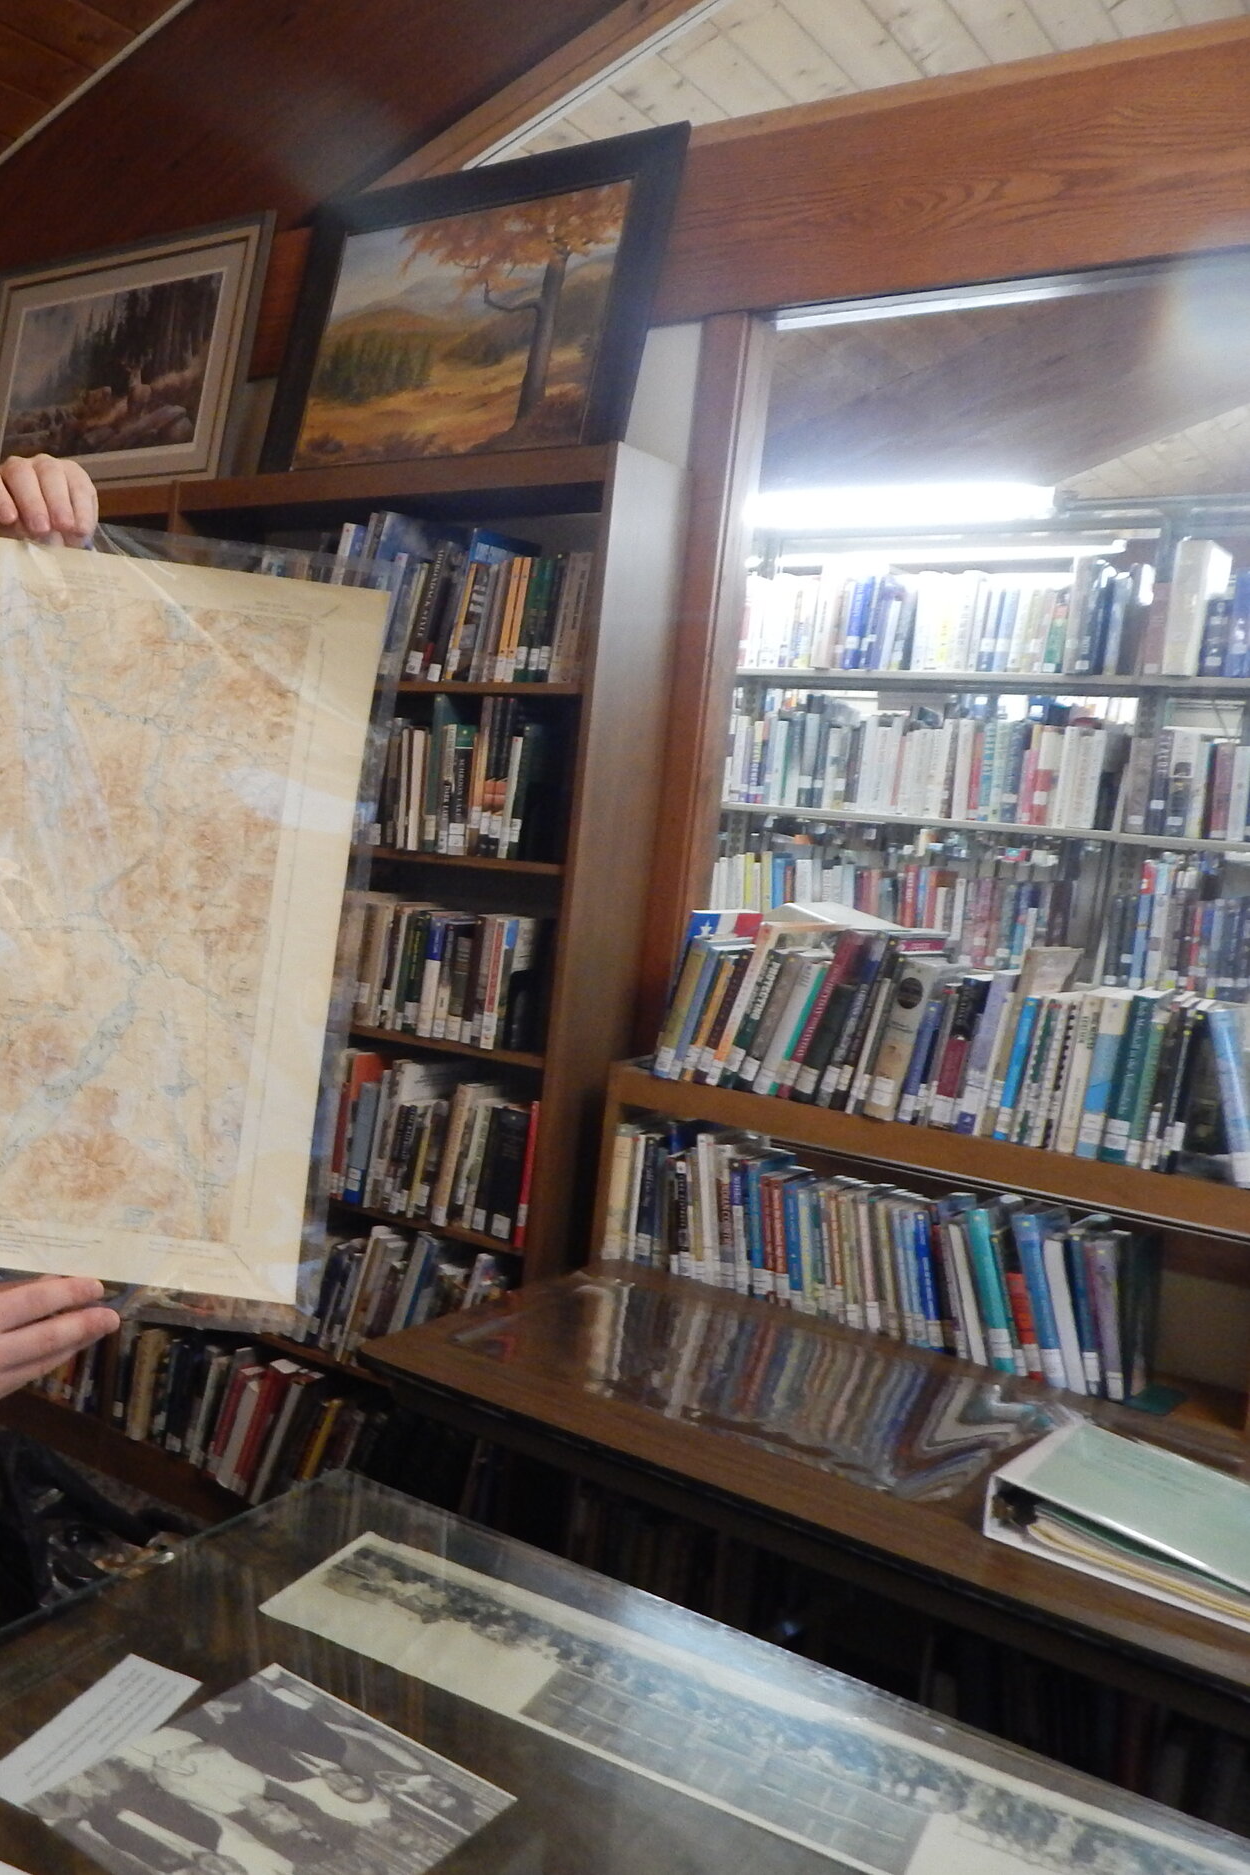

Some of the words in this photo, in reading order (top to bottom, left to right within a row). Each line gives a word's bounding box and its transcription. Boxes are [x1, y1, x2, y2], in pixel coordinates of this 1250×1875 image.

[424, 549, 445, 607] ADIRONDACK
[416, 610, 430, 638] STYLE
[751, 961, 781, 1020] PROTECTING
